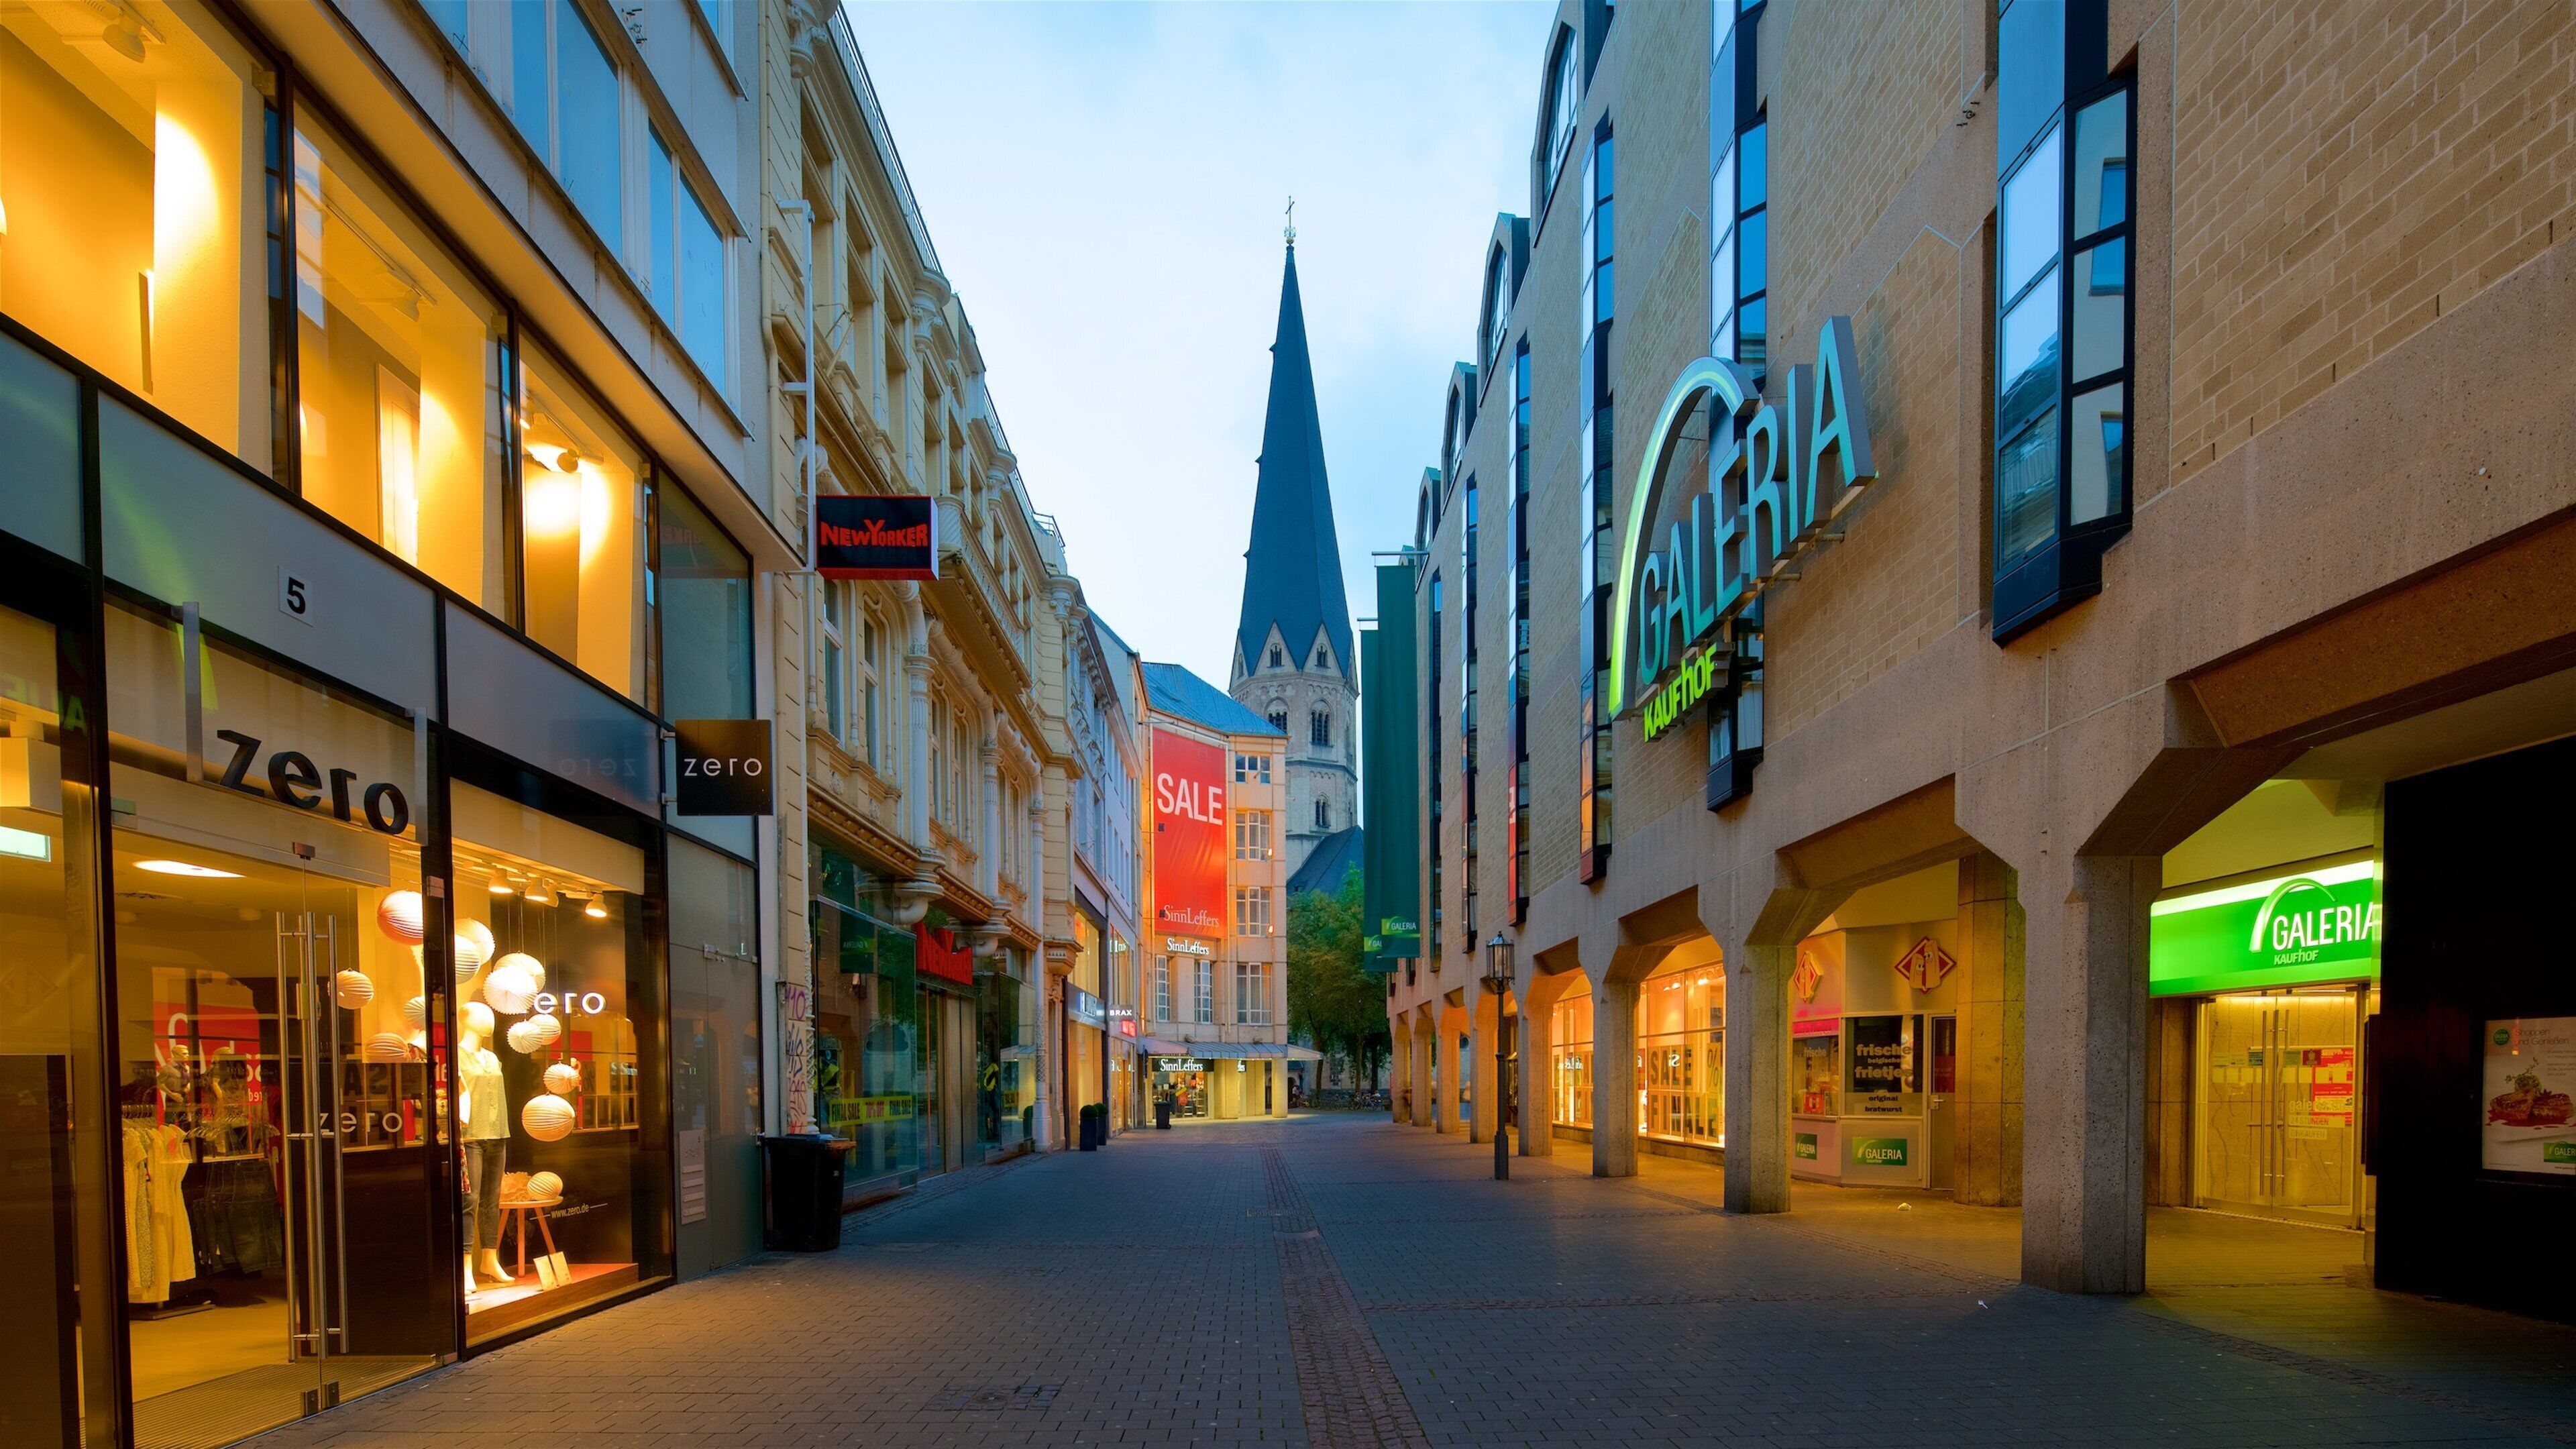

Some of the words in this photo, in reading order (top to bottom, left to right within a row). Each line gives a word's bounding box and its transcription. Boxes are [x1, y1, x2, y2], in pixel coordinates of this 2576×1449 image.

[1640, 315, 1876, 685] GALERIA
[286, 576, 306, 614] 5
[684, 757, 763, 777] zero
[217, 729, 409, 835] zero
[1157, 772, 1223, 826] SALE
[1163, 904, 1220, 928] SinnLeffers
[1391, 921, 1416, 930] GALERIA
[1167, 937, 1210, 955] SinnLeffers
[519, 991, 606, 1015] ero
[1856, 1044, 1912, 1056] frische
[1160, 1058, 1203, 1071] SinnLeffers
[1650, 1049, 1692, 1086] SALE
[1868, 1095, 1898, 1103] original
[847, 1102, 860, 1120] SALE
[1650, 1094, 1718, 1138] FINALE
[1864, 1106, 1902, 1114] bratwurst
[1865, 1148, 1902, 1161] GALERIA
[551, 1203, 590, 1219] www.zero.de
